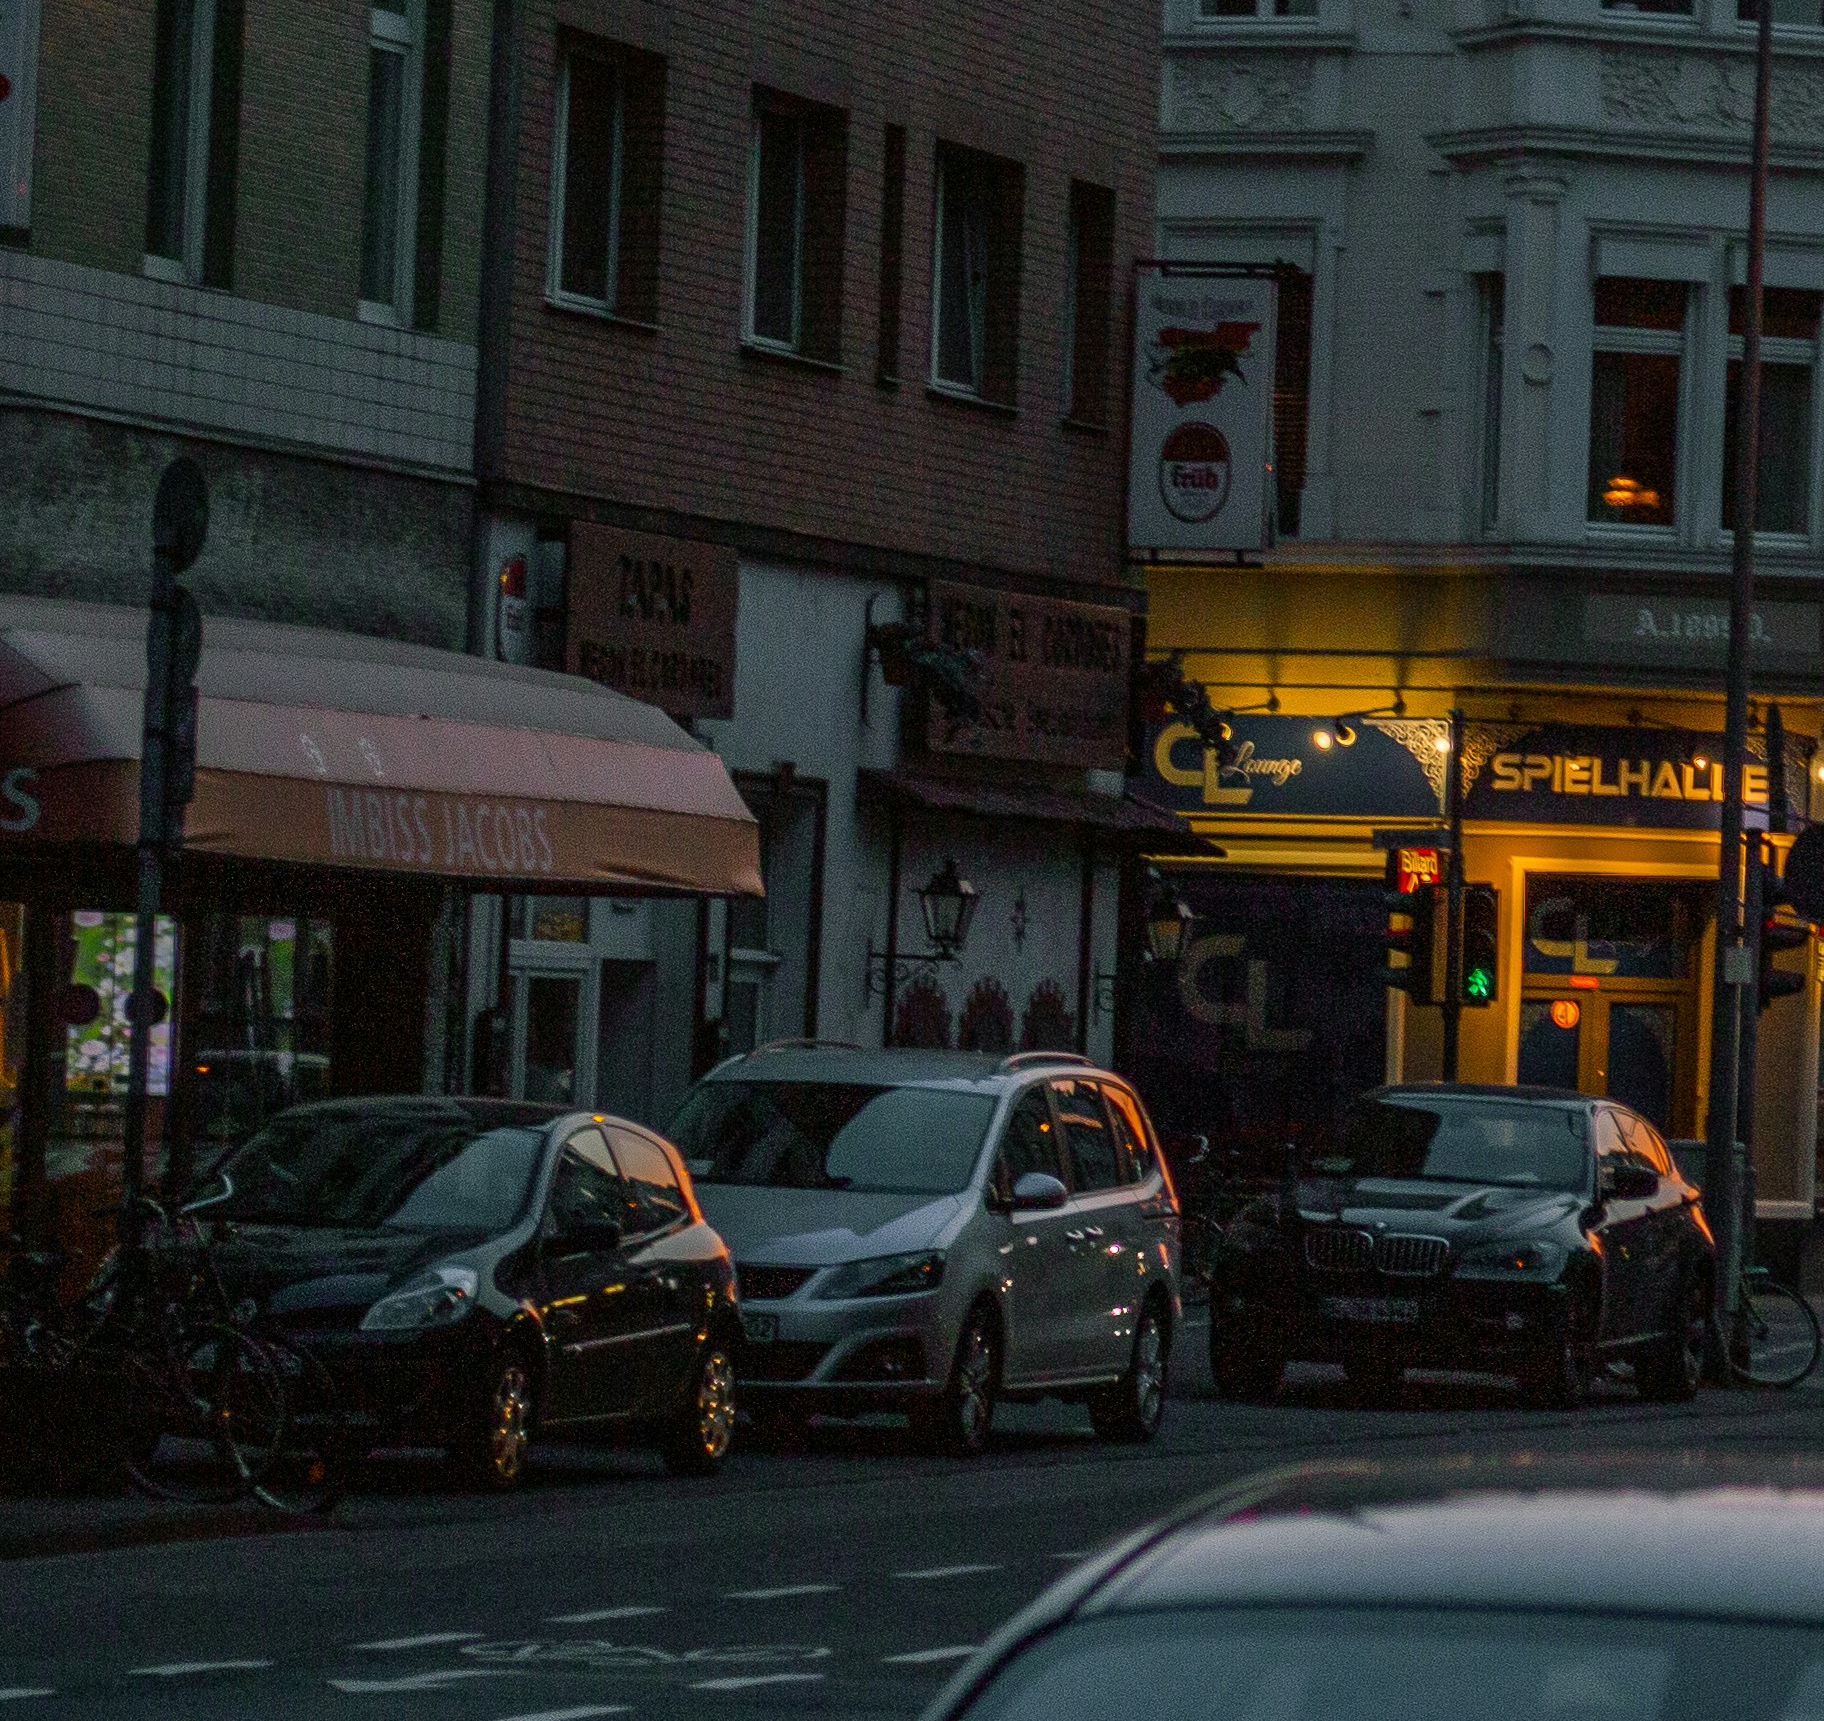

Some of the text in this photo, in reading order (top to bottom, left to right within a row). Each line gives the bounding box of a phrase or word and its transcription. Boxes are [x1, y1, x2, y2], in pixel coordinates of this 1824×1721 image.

[1221, 739, 1303, 787] Lounge
[1490, 751, 1770, 803] SPIELHALLE
[326, 787, 553, 873] IMBISS JACOBS
